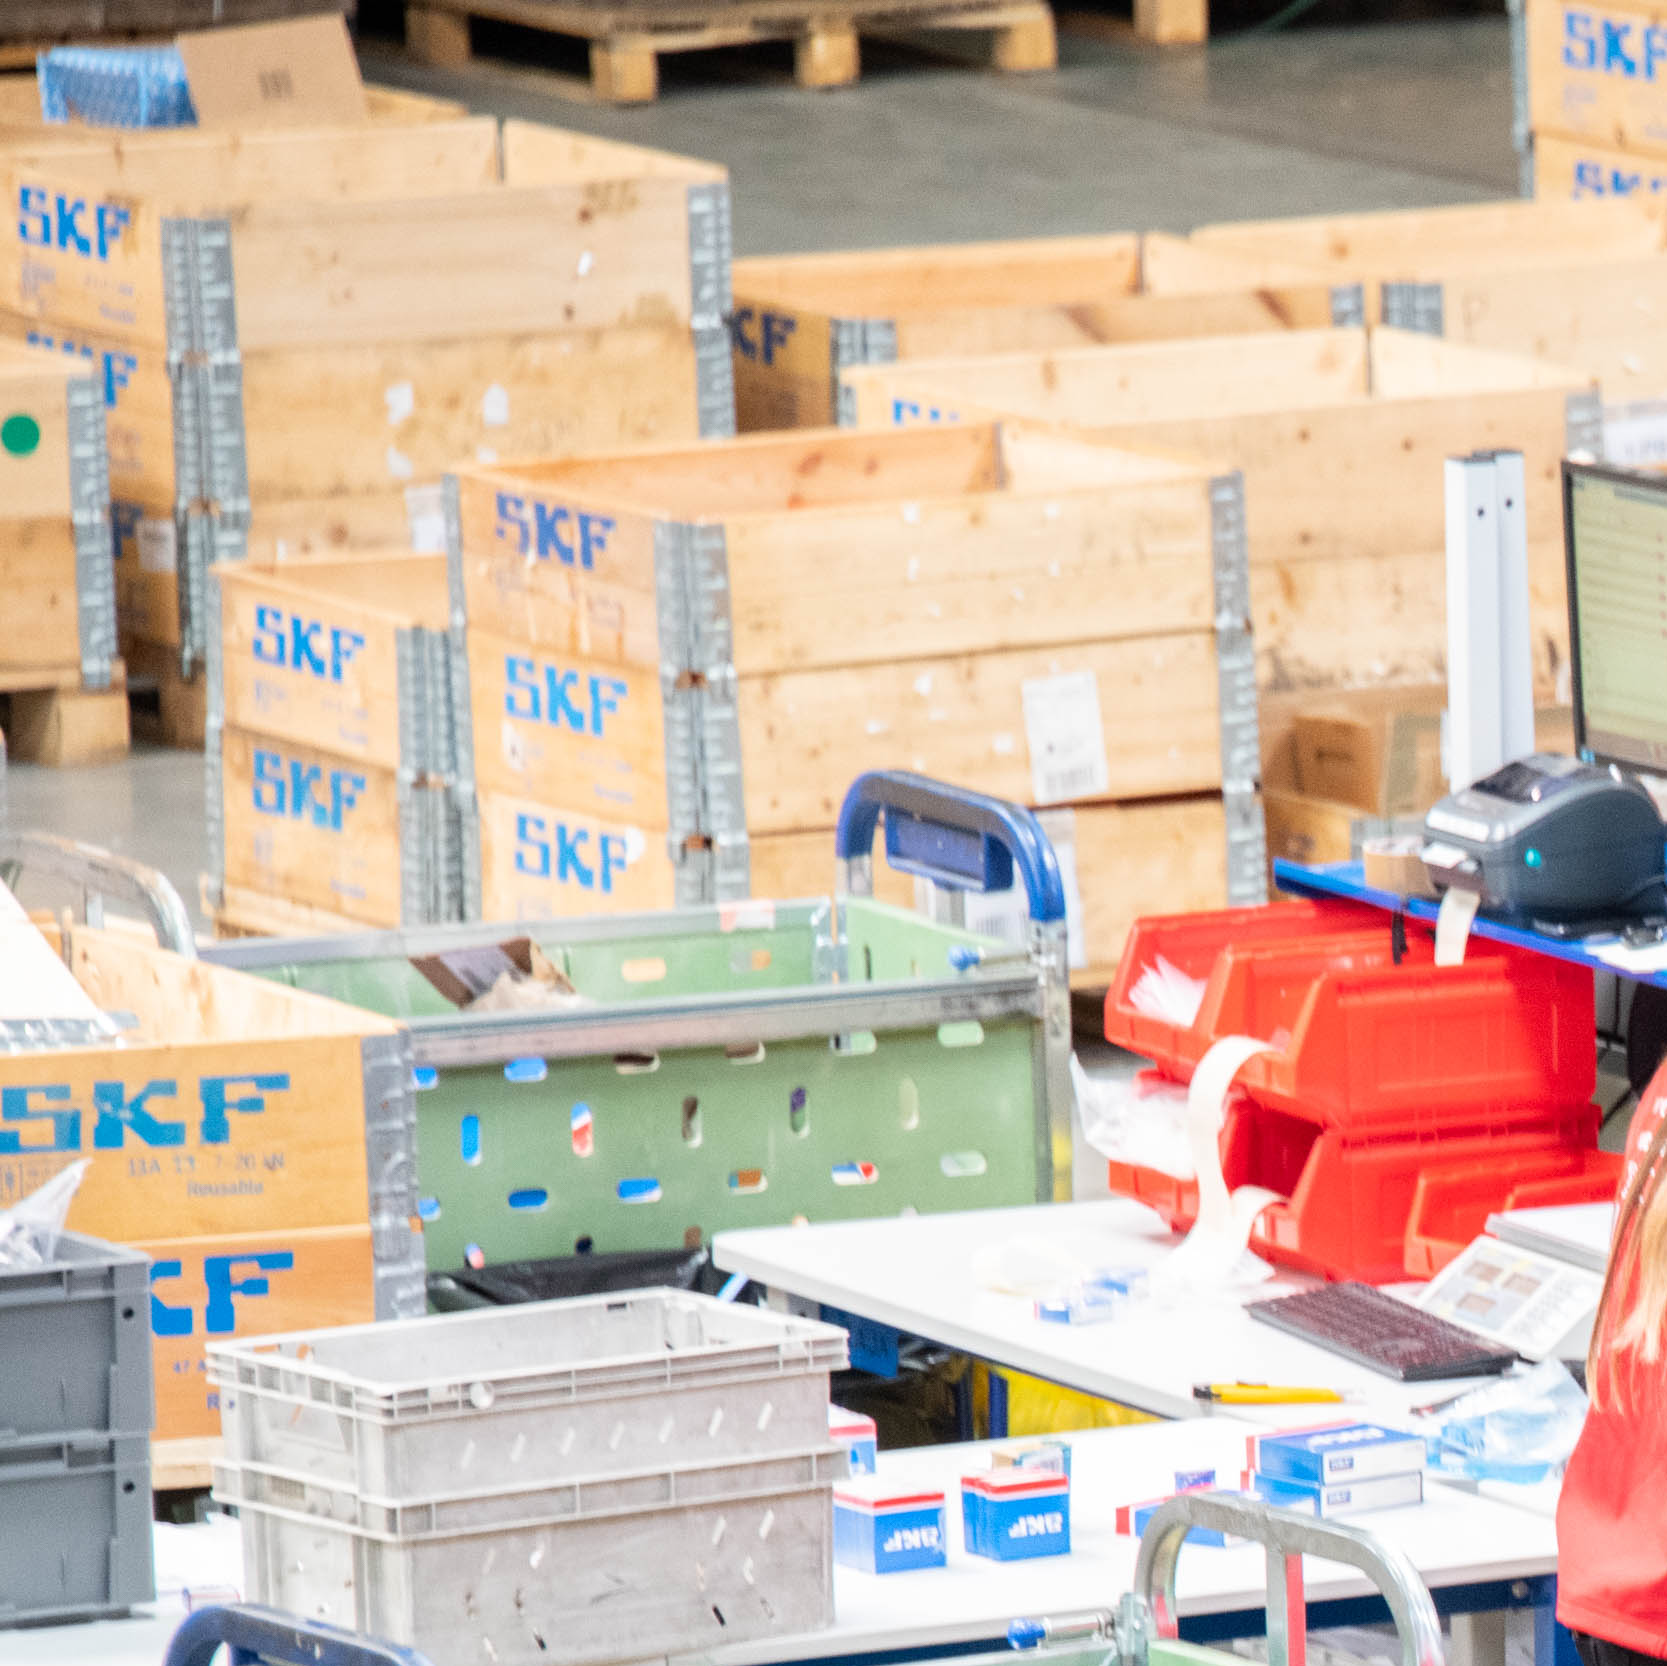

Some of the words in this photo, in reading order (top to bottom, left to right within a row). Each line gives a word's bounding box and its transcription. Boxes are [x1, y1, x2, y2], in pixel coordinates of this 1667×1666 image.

[18, 184, 131, 262] SKF
[496, 491, 616, 570] SKF
[252, 603, 366, 684] SKF
[504, 654, 628, 736] SKF
[252, 748, 366, 832] SKF
[514, 812, 629, 894] SKF
[0, 1073, 290, 1154] SKF
[884, 1526, 940, 1551] SKF
[1008, 1511, 1063, 1539] SKF
